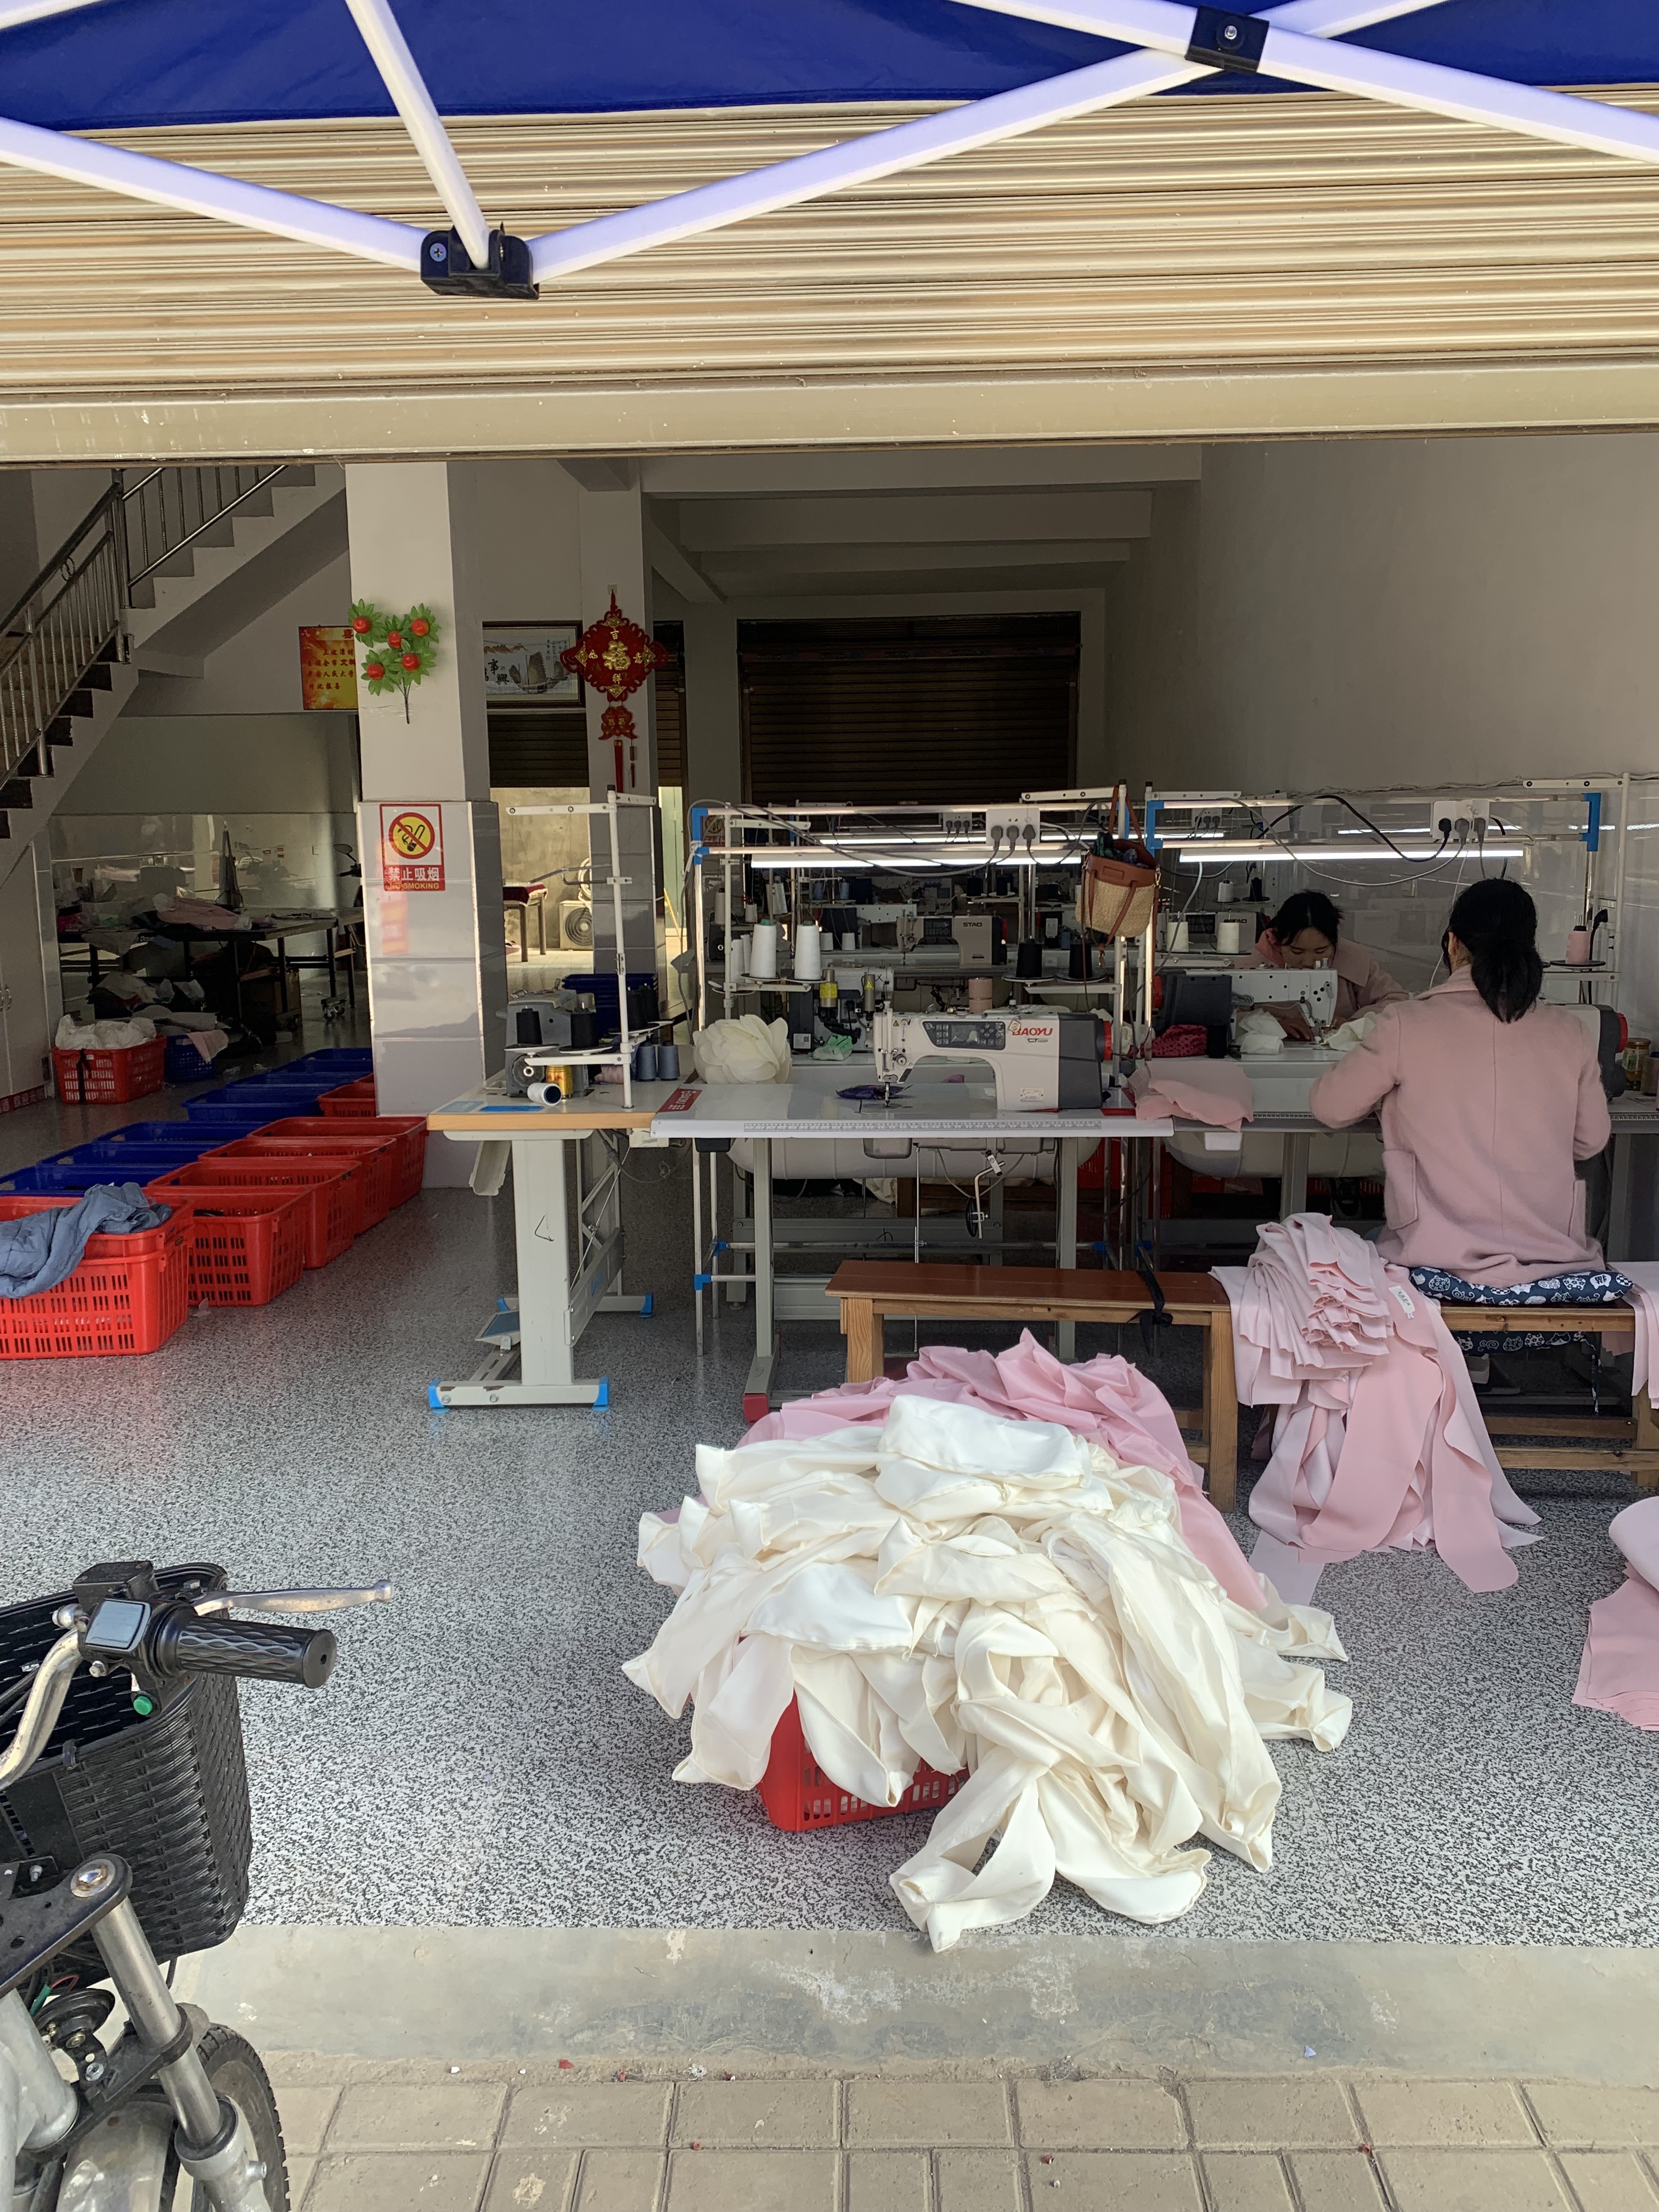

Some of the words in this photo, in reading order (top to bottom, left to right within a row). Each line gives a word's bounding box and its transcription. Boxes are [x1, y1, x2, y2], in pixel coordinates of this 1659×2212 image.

[610, 629, 619, 640] 吉
[601, 640, 631, 670] 福
[388, 867, 439, 881] 禁止吸烟
[1012, 1028, 1053, 1036] BAOYU
